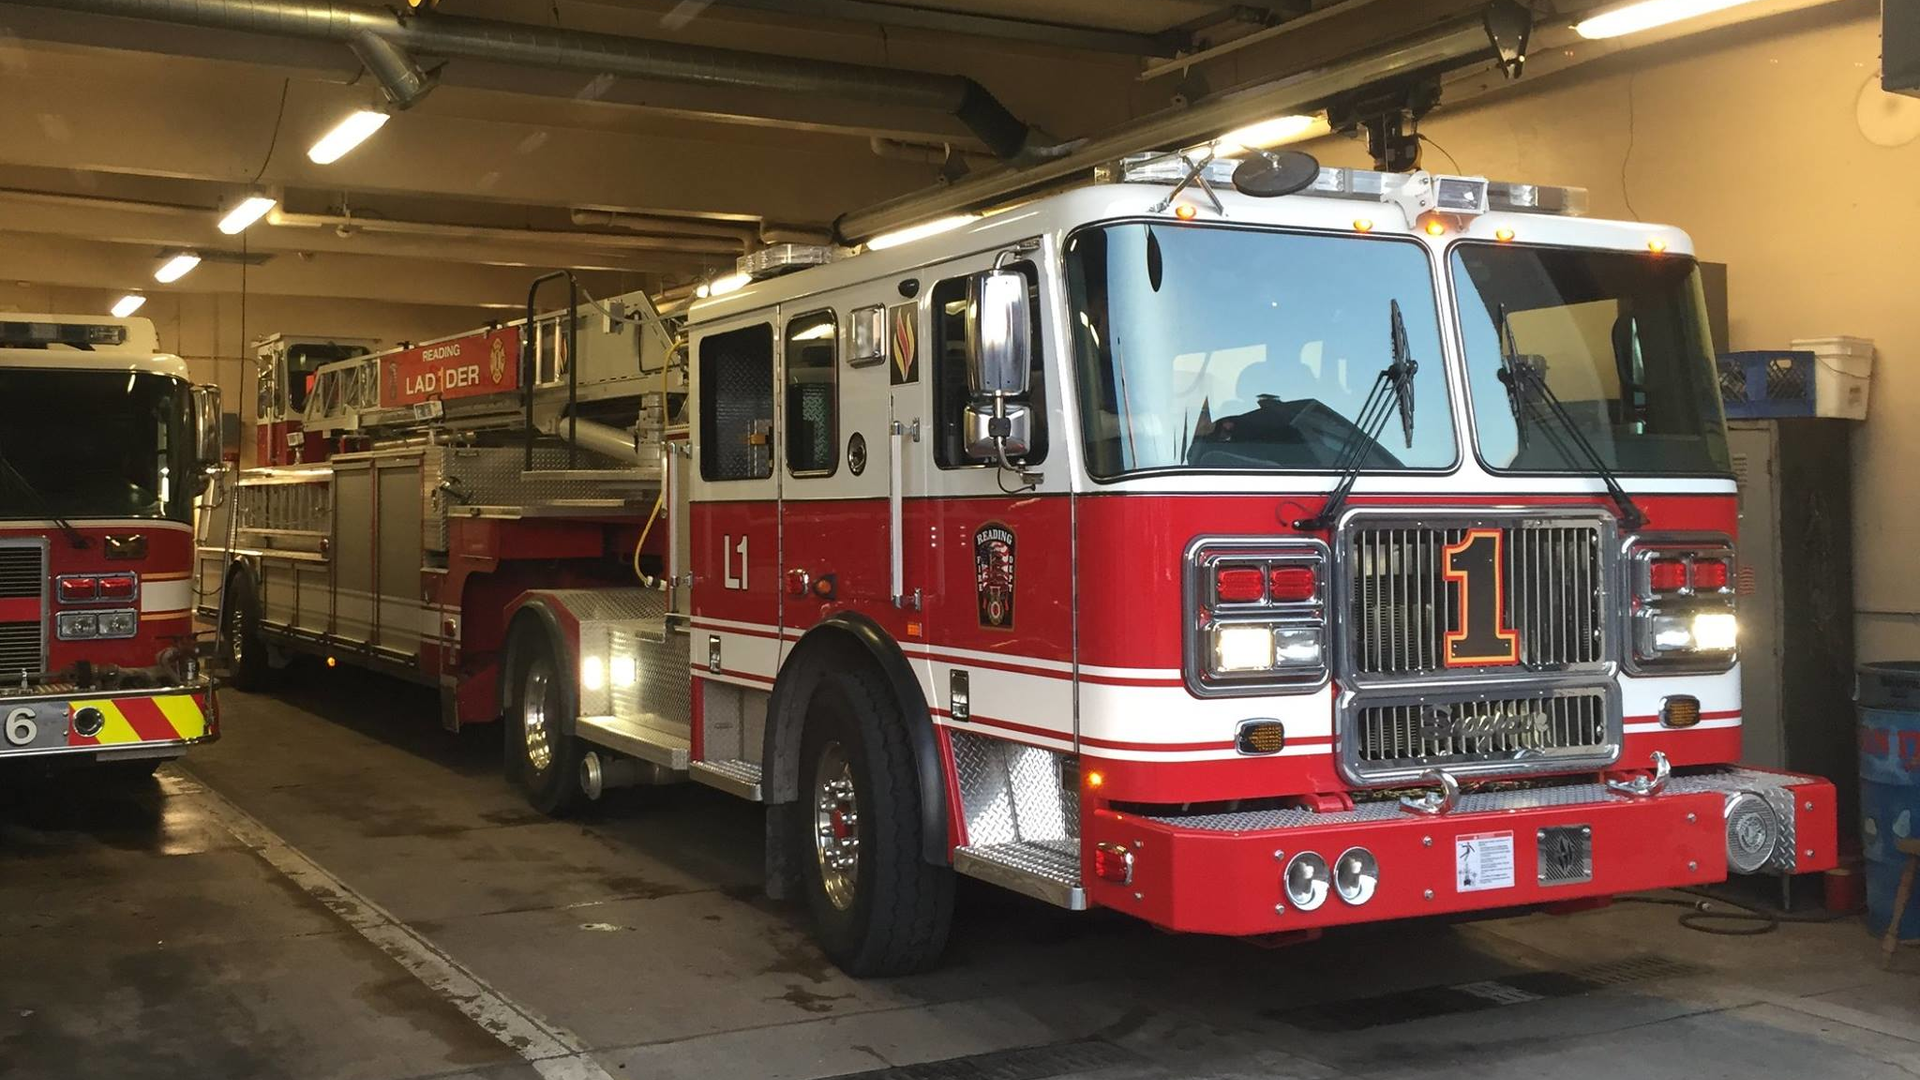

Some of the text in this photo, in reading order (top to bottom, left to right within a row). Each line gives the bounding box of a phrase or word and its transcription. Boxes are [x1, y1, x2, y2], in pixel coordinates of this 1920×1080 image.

[422, 344, 461, 362] READING
[976, 529, 1013, 545] READING
[724, 534, 748, 590] L1
[1443, 528, 1520, 668] 1
[5, 707, 38, 745] 6
